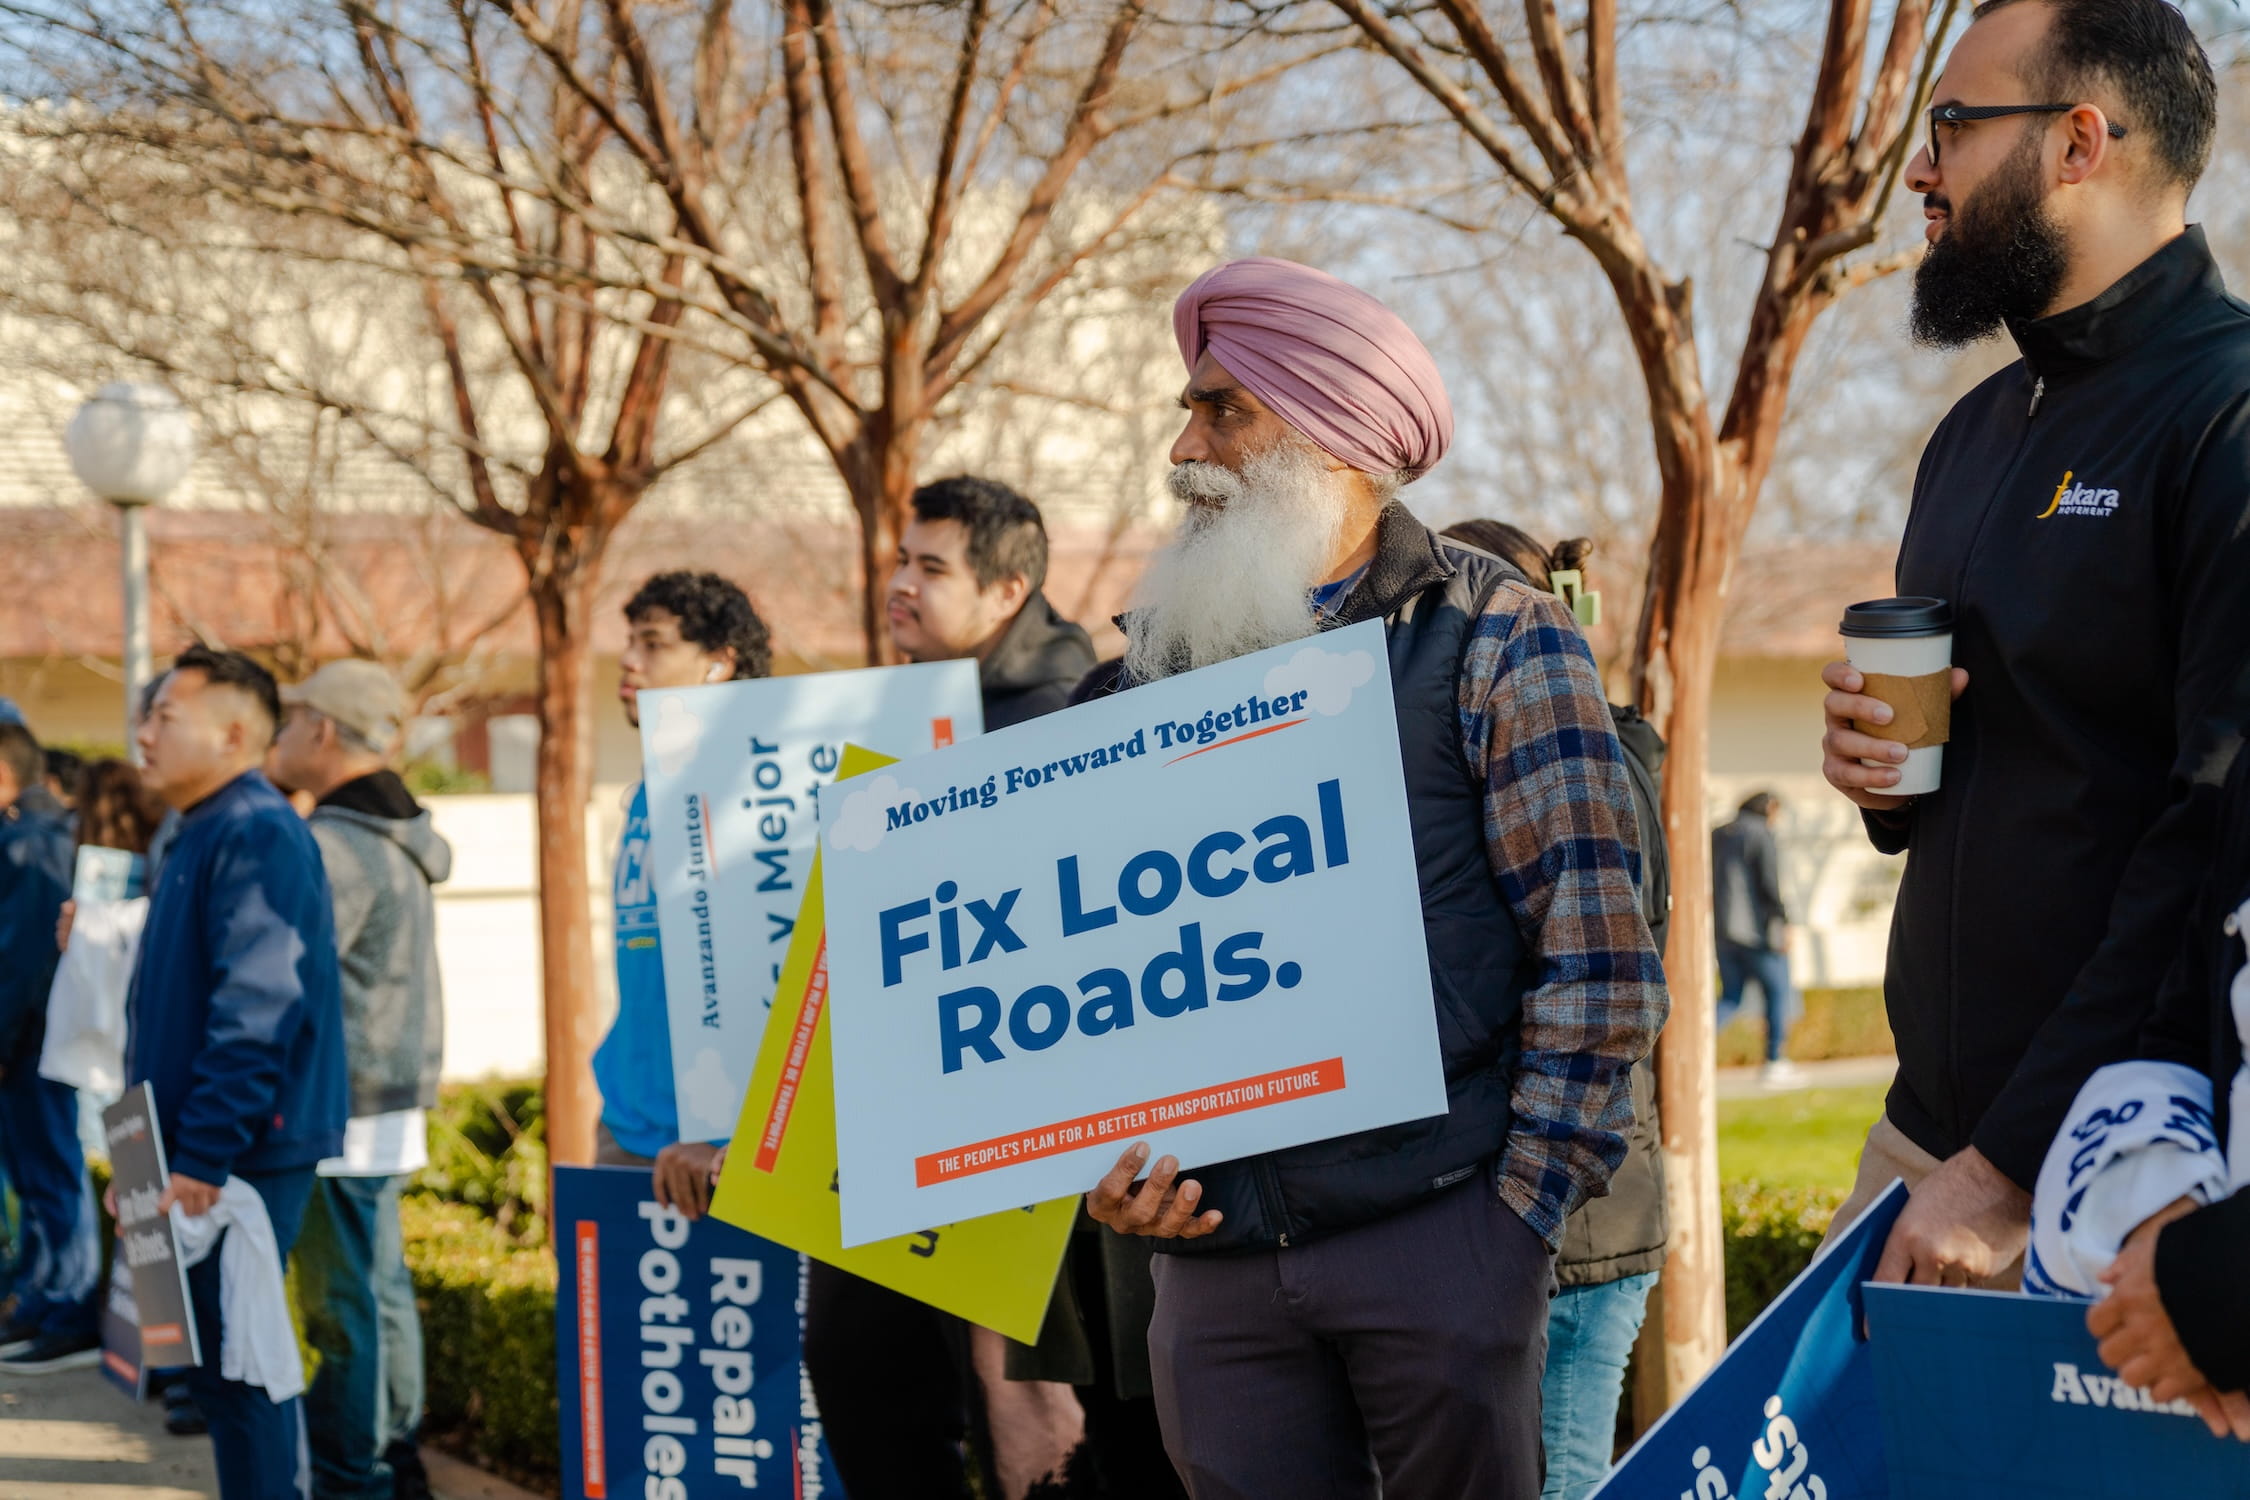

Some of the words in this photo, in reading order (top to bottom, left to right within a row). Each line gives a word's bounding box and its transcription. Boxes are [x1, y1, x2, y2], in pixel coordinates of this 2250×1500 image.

[2057, 505, 2113, 517] MOVEMENT
[742, 735, 795, 893] Mejor
[885, 774, 998, 832] Moving
[1004, 728, 1147, 795] Forward
[1154, 689, 1308, 749] Together
[686, 793, 706, 880] Juntos
[879, 880, 1028, 988] Fix
[1056, 778, 1350, 938] Local
[691, 889, 720, 1029] Avanzando
[937, 921, 1303, 1075] Roads.
[764, 1083, 795, 1150] TRANSPORTE
[937, 1155, 961, 1174] THE
[964, 1140, 1020, 1167] PEOPLE'S
[1023, 1131, 1055, 1153] PLAN
[1059, 1125, 1083, 1145] FOR
[1086, 1123, 1095, 1138] A
[1098, 1110, 1147, 1136] BETTER
[1150, 1083, 1264, 1123] TRANSPORTATION
[1267, 1070, 1320, 1097] FUTURE
[699, 1256, 774, 1490] Repair
